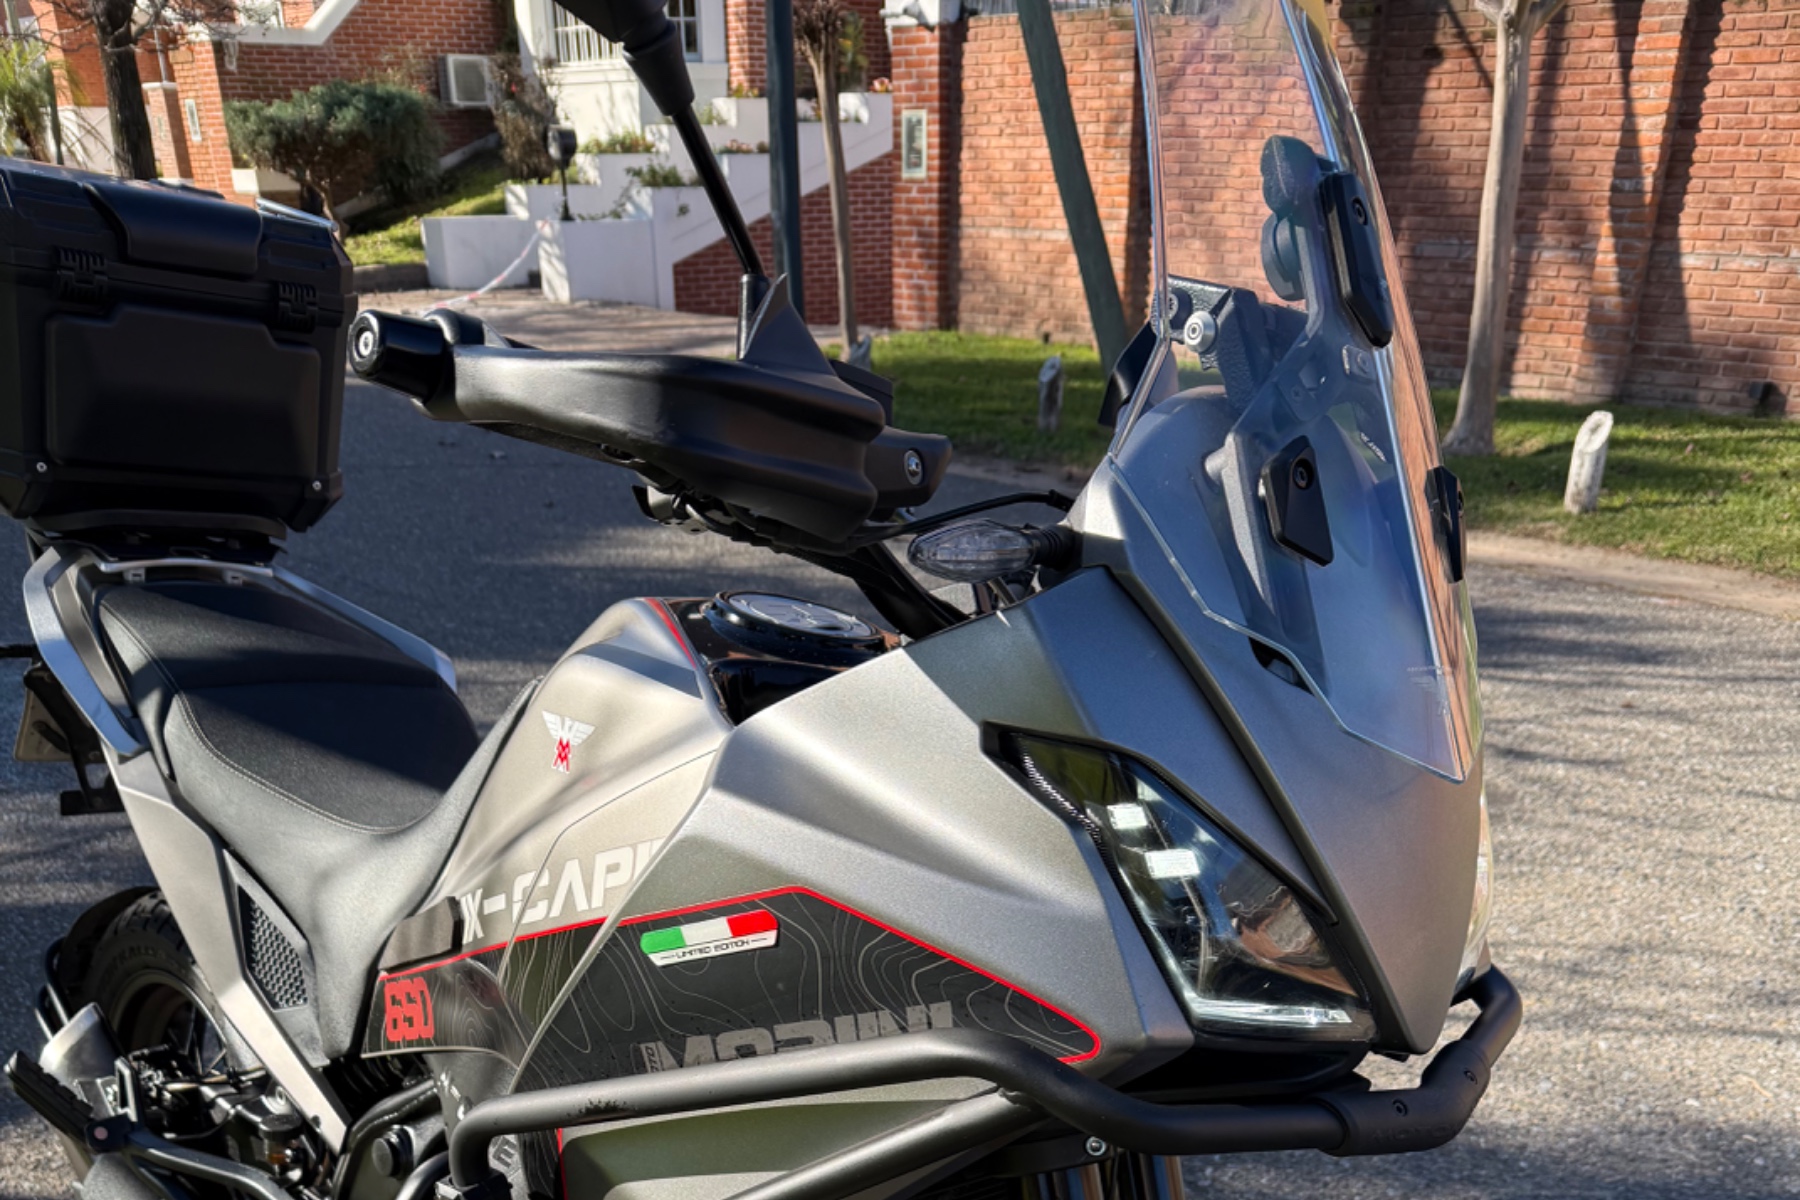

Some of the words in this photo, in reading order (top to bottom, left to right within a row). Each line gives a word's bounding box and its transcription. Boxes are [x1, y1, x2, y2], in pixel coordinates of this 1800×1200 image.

[676, 946, 712, 959] LIMITED
[714, 939, 749, 952] EDITION
[384, 976, 434, 1042] 650
